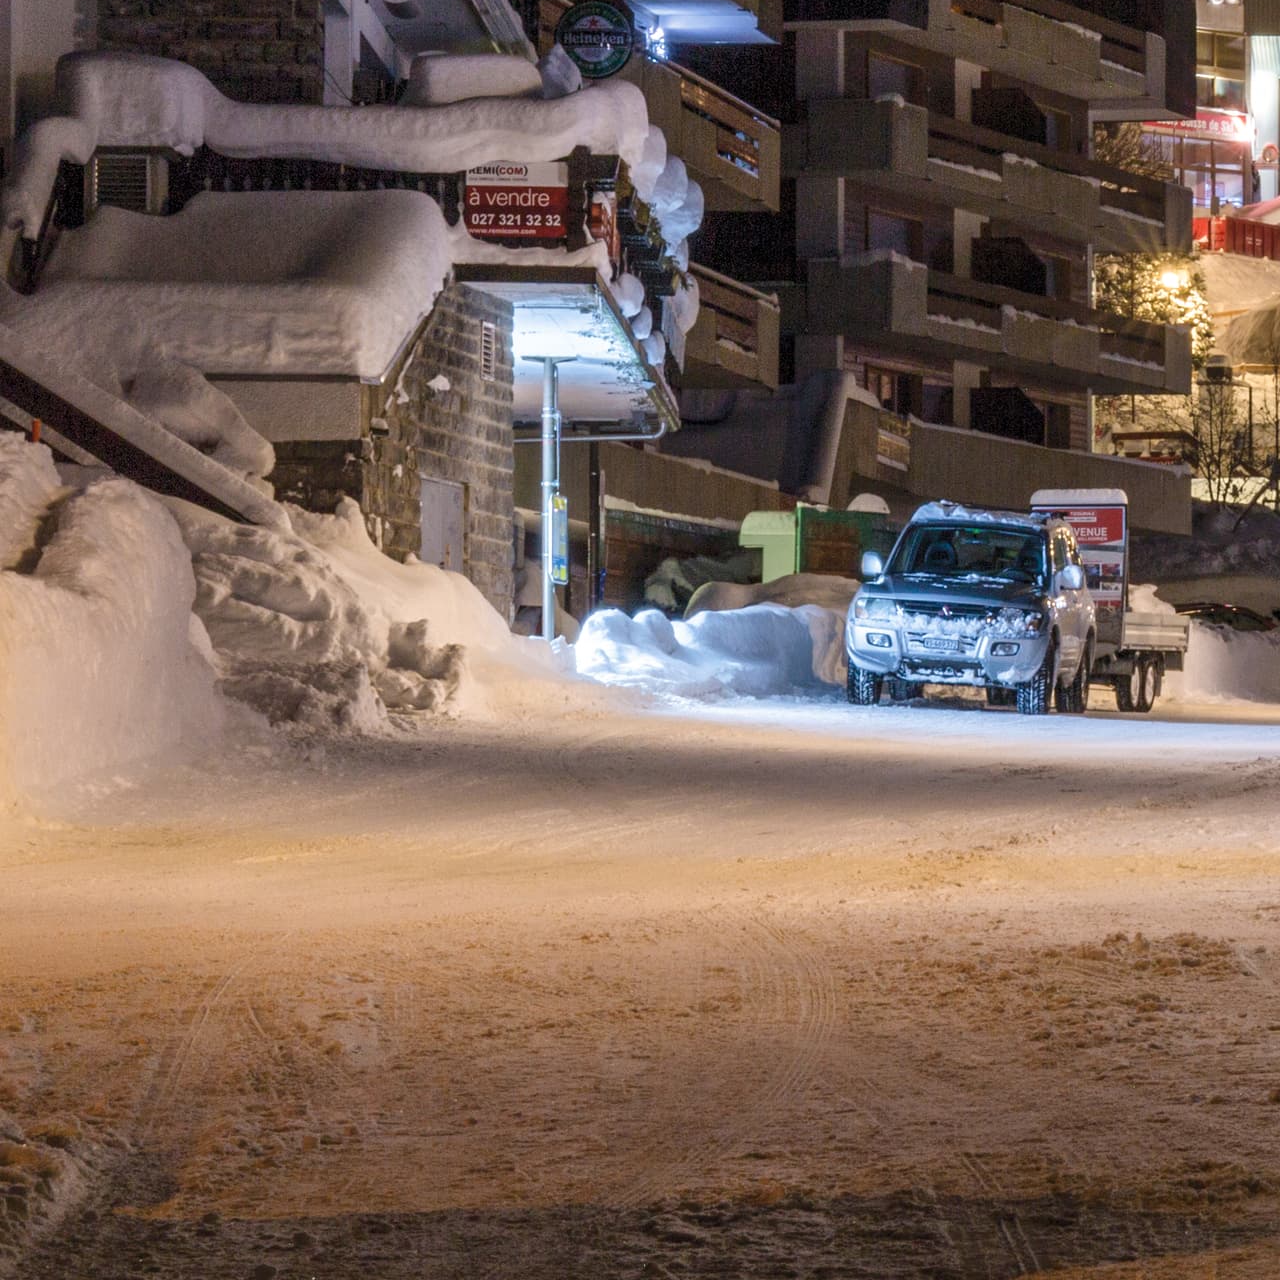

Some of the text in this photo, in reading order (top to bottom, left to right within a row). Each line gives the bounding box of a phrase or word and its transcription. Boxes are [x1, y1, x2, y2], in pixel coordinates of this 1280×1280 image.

[564, 32, 625, 45] Heineken
[469, 187, 551, 208] à vendre
[471, 213, 561, 227] 027 321 32 32
[1072, 527, 1108, 537] VENUE
